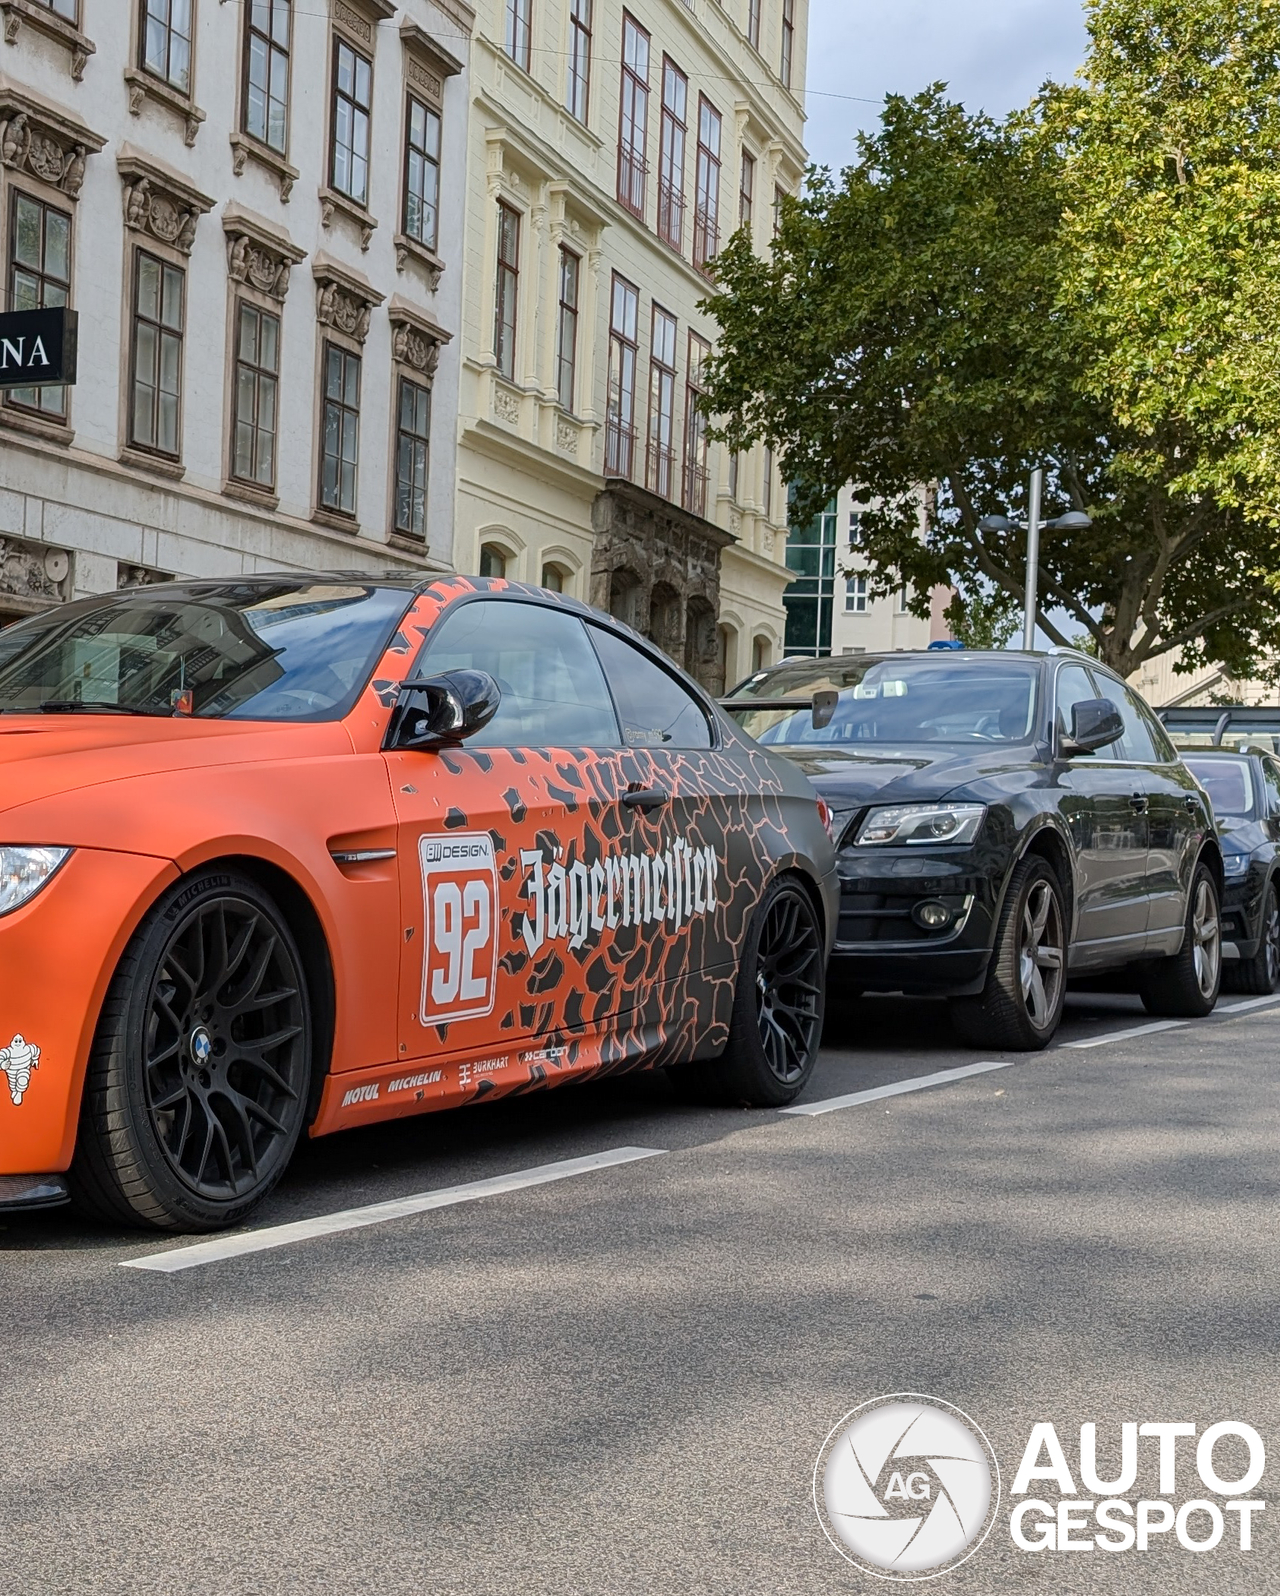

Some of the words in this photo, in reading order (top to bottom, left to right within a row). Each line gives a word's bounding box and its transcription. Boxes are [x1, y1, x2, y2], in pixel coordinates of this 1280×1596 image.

[179, 876, 228, 906] MICHELIN
[431, 880, 489, 1004] 92
[472, 1056, 509, 1075] BURKHART
[387, 1070, 442, 1094] MICHELIN
[341, 1083, 380, 1108] MOTUL
